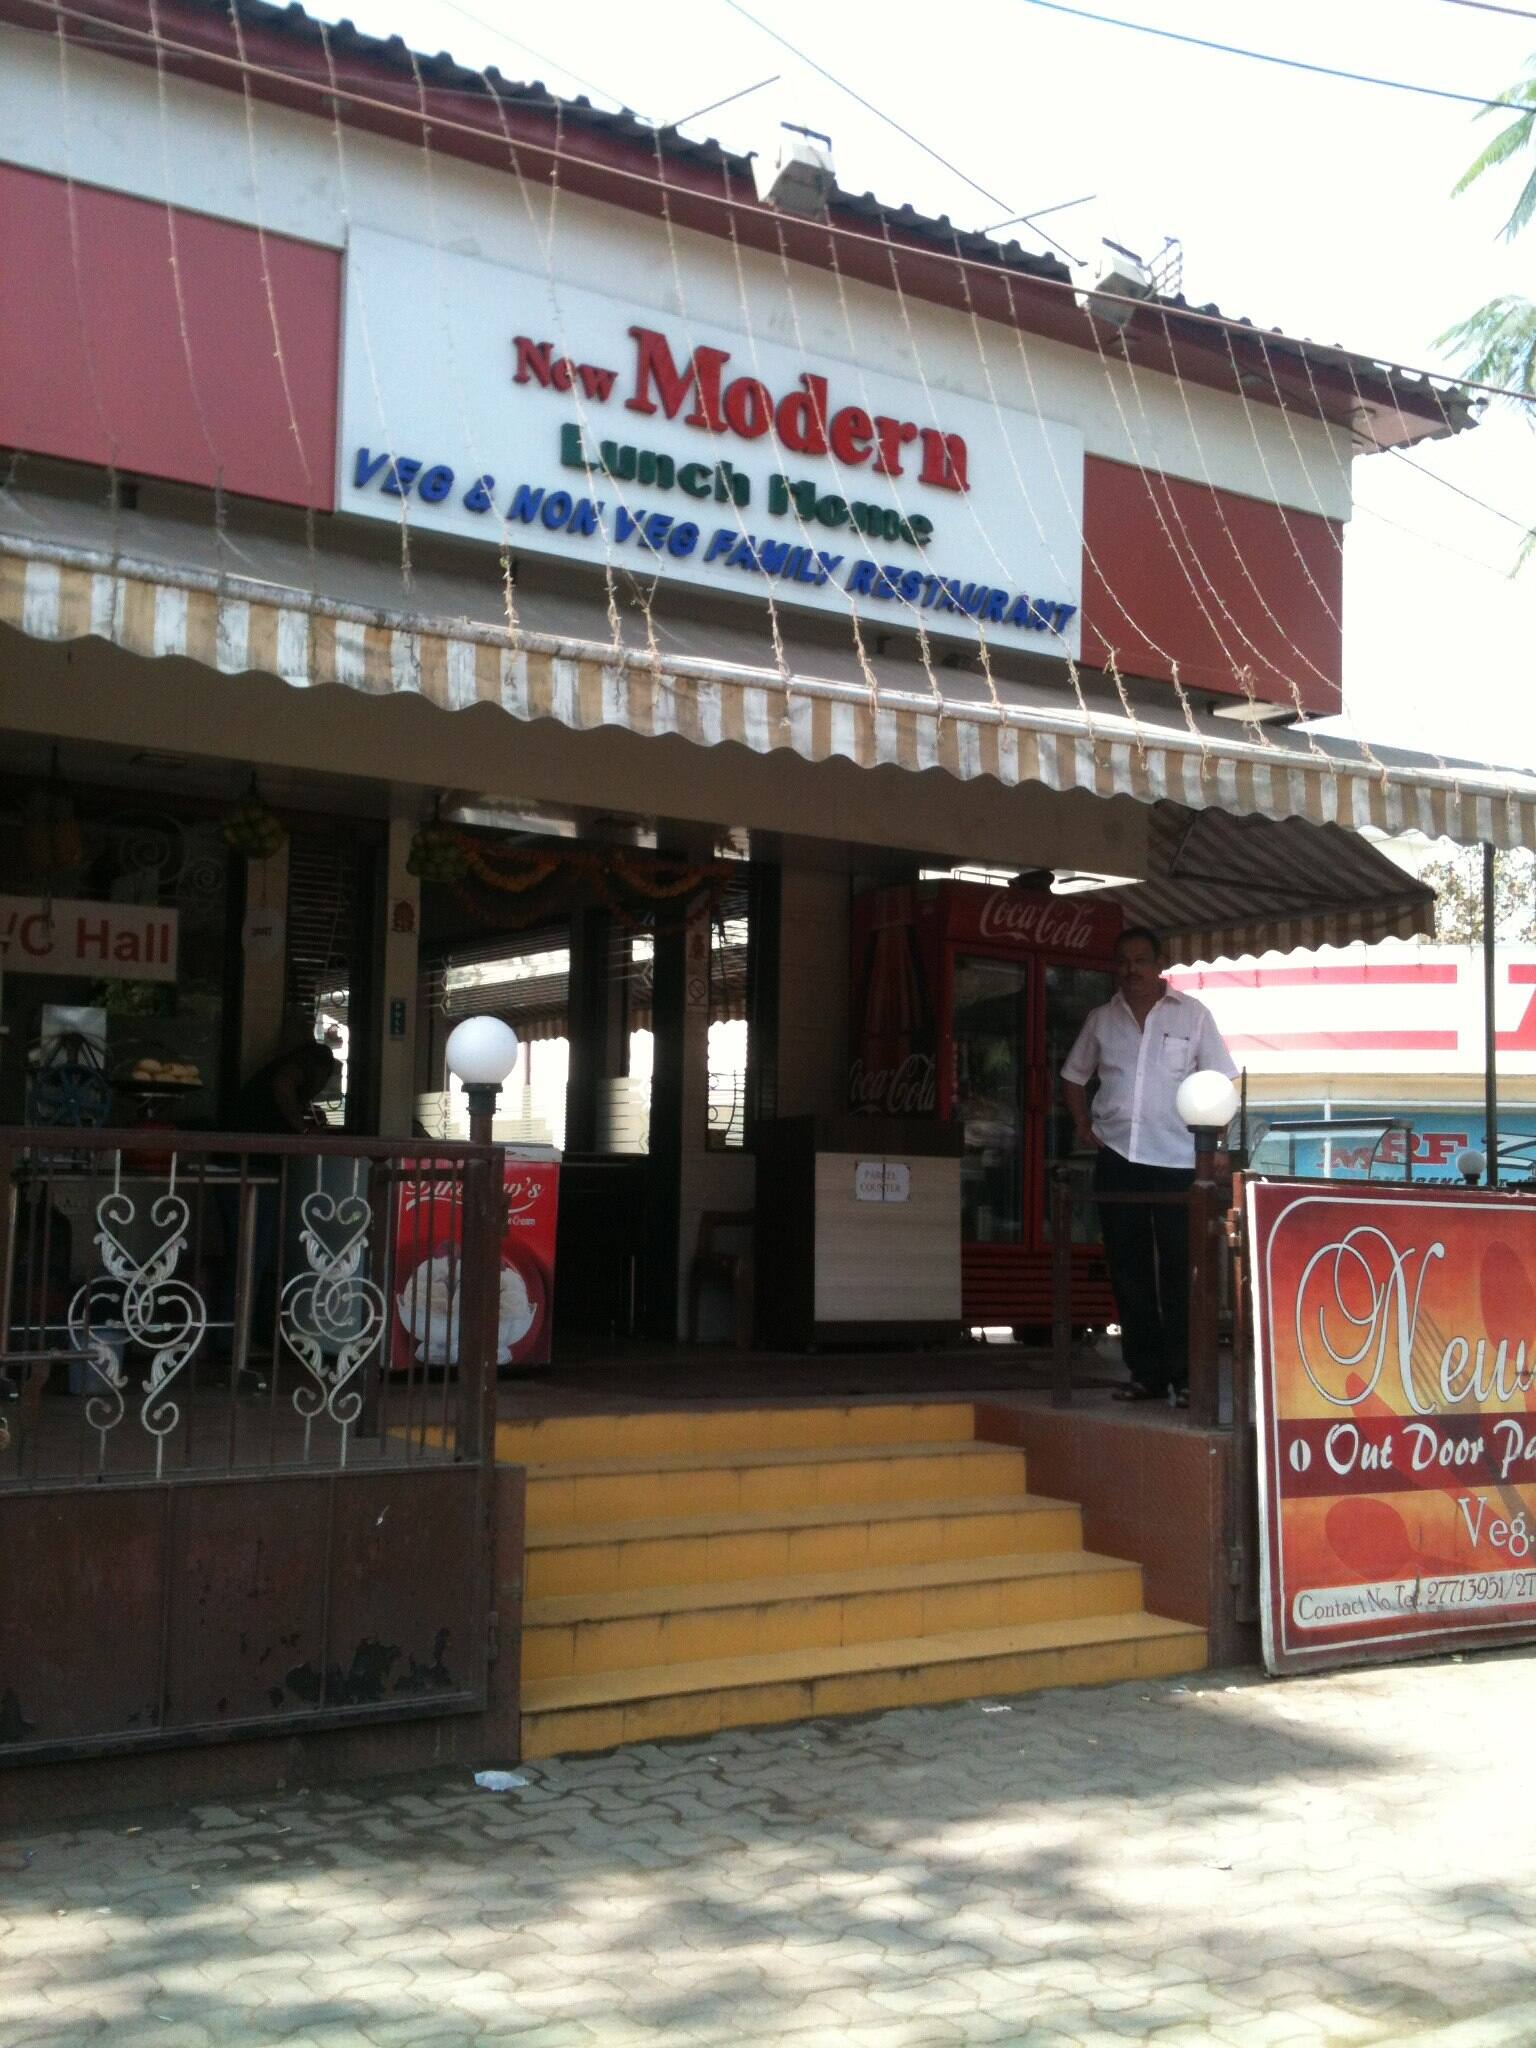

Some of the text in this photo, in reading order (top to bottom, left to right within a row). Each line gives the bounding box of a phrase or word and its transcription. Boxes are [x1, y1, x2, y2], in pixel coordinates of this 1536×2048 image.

[512, 326, 970, 492] New Modern
[354, 448, 1078, 634] VEG & NON VEG FAMILY RESTAURANT
[561, 422, 933, 547] Lunch Home
[0, 912, 170, 964] /C Hall
[1296, 1225, 1536, 1415] New
[1325, 1423, 1392, 1475] Out
[1402, 1423, 1484, 1471] Door
[1298, 1594, 1366, 1620] Contact
